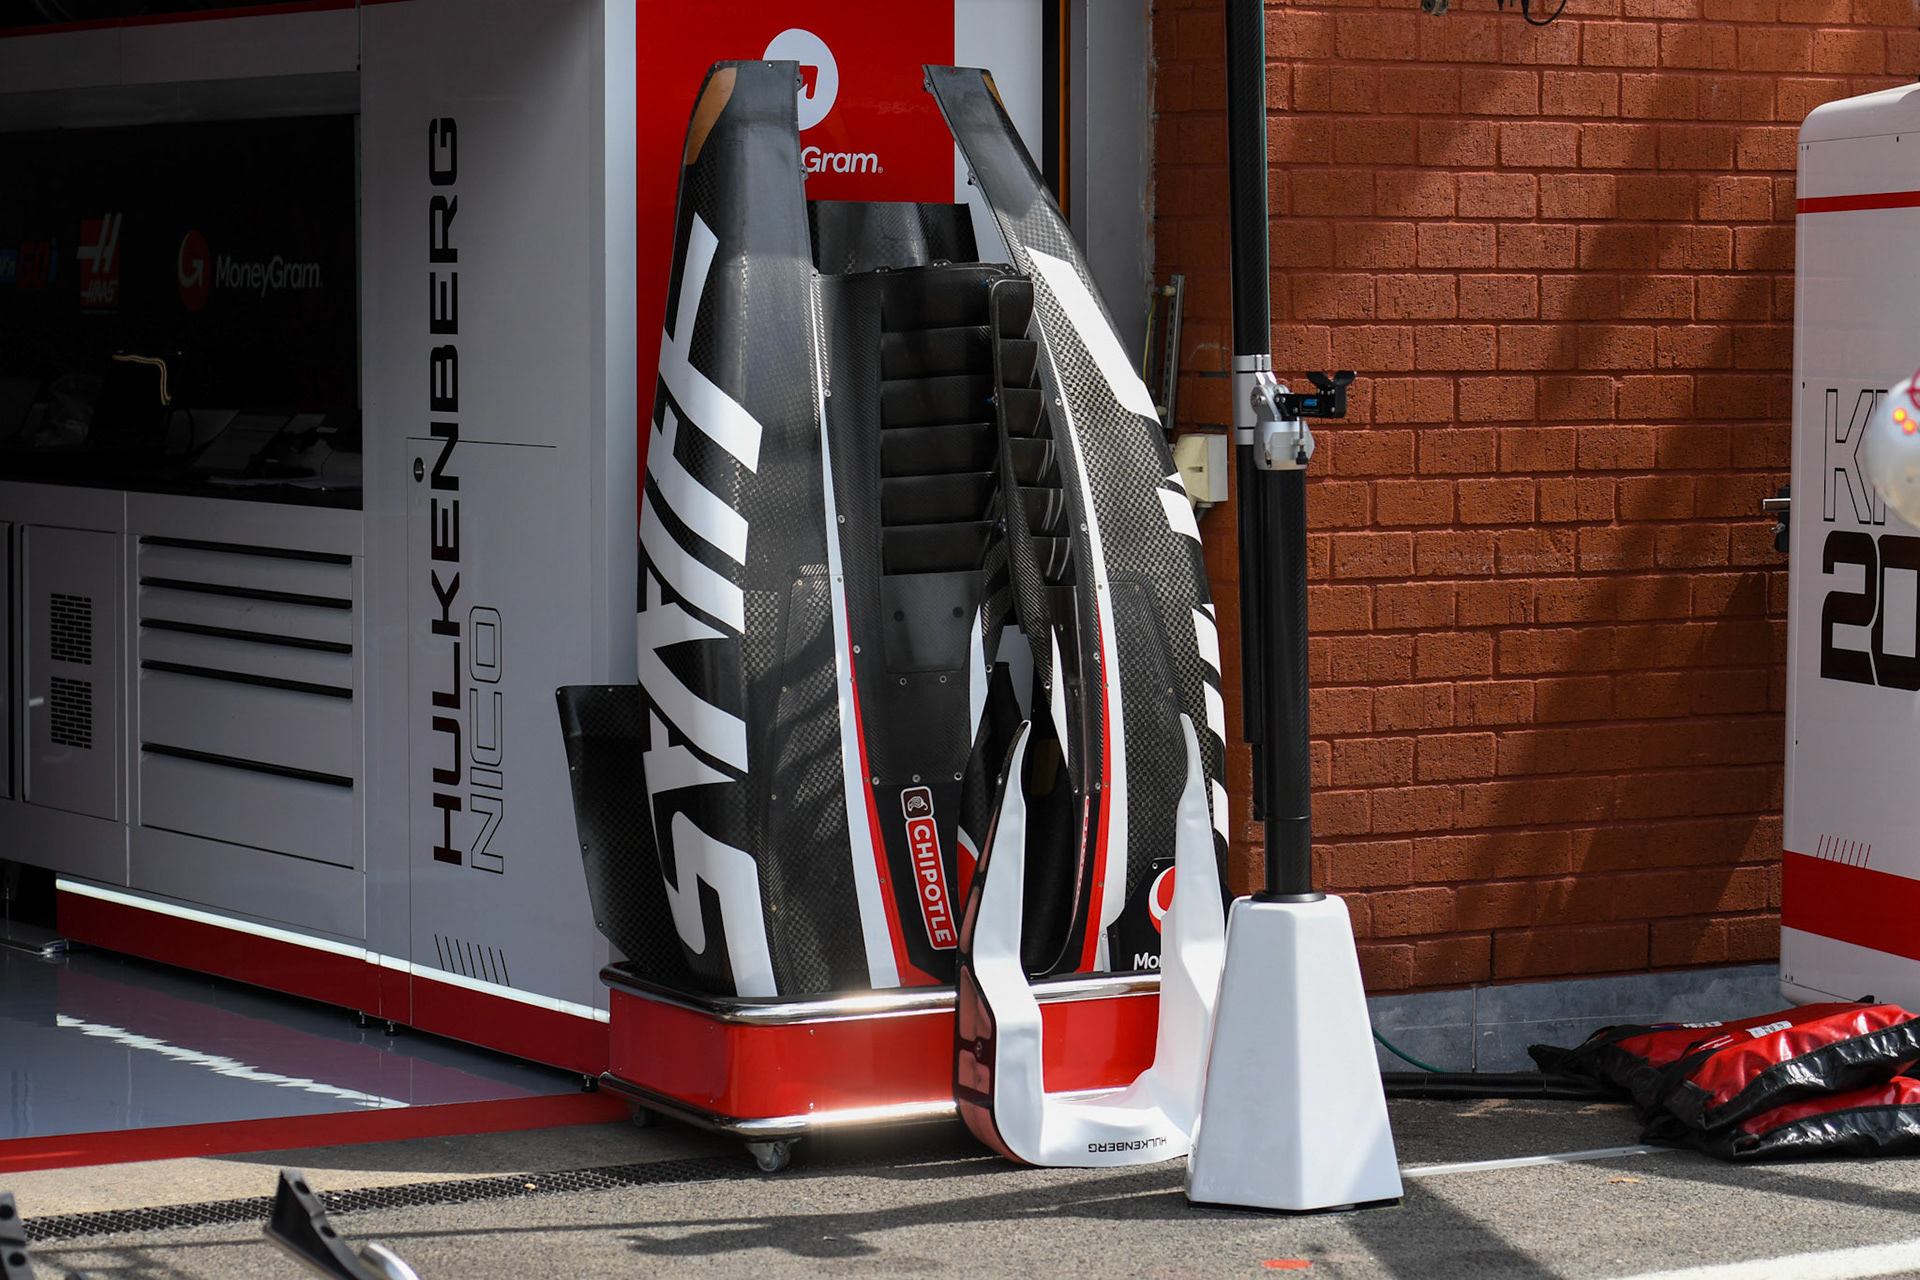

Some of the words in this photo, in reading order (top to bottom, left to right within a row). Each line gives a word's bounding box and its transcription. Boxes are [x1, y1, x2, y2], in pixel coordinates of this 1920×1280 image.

[801, 146, 878, 173] Gram
[215, 255, 320, 297] MoneyGram
[430, 117, 462, 866] HULKENBERG
[637, 212, 778, 998] HAAS
[1820, 530, 1920, 692] 20
[469, 605, 504, 875] NICO
[914, 824, 952, 943] CHIPOTLE
[1088, 1136, 1167, 1153] HULKENBERG
